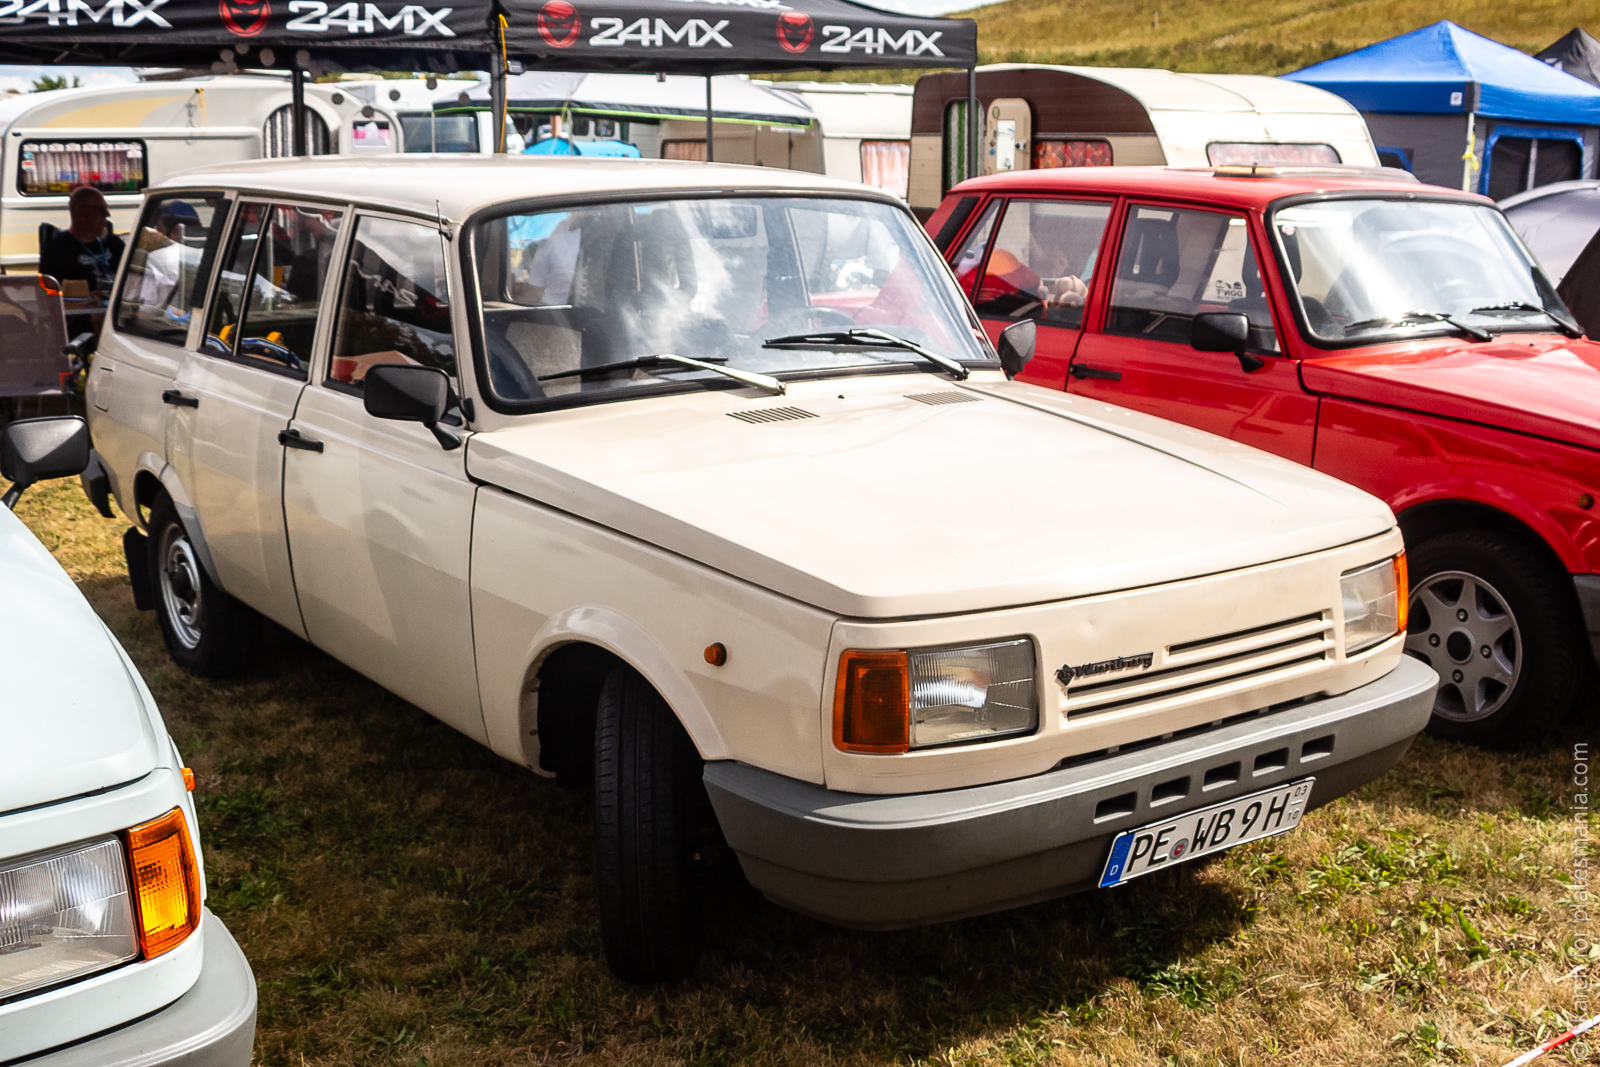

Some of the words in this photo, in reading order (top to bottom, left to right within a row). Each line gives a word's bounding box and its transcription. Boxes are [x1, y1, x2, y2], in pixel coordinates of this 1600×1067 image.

[286, 0, 456, 37] 24MX
[589, 17, 733, 48] 24MX
[820, 24, 945, 57] 24MX
[1294, 784, 1308, 798] 03
[1286, 809, 1300, 822] 10
[1126, 825, 1177, 873] PE
[1189, 808, 1236, 854] WB
[1109, 864, 1119, 876] D
